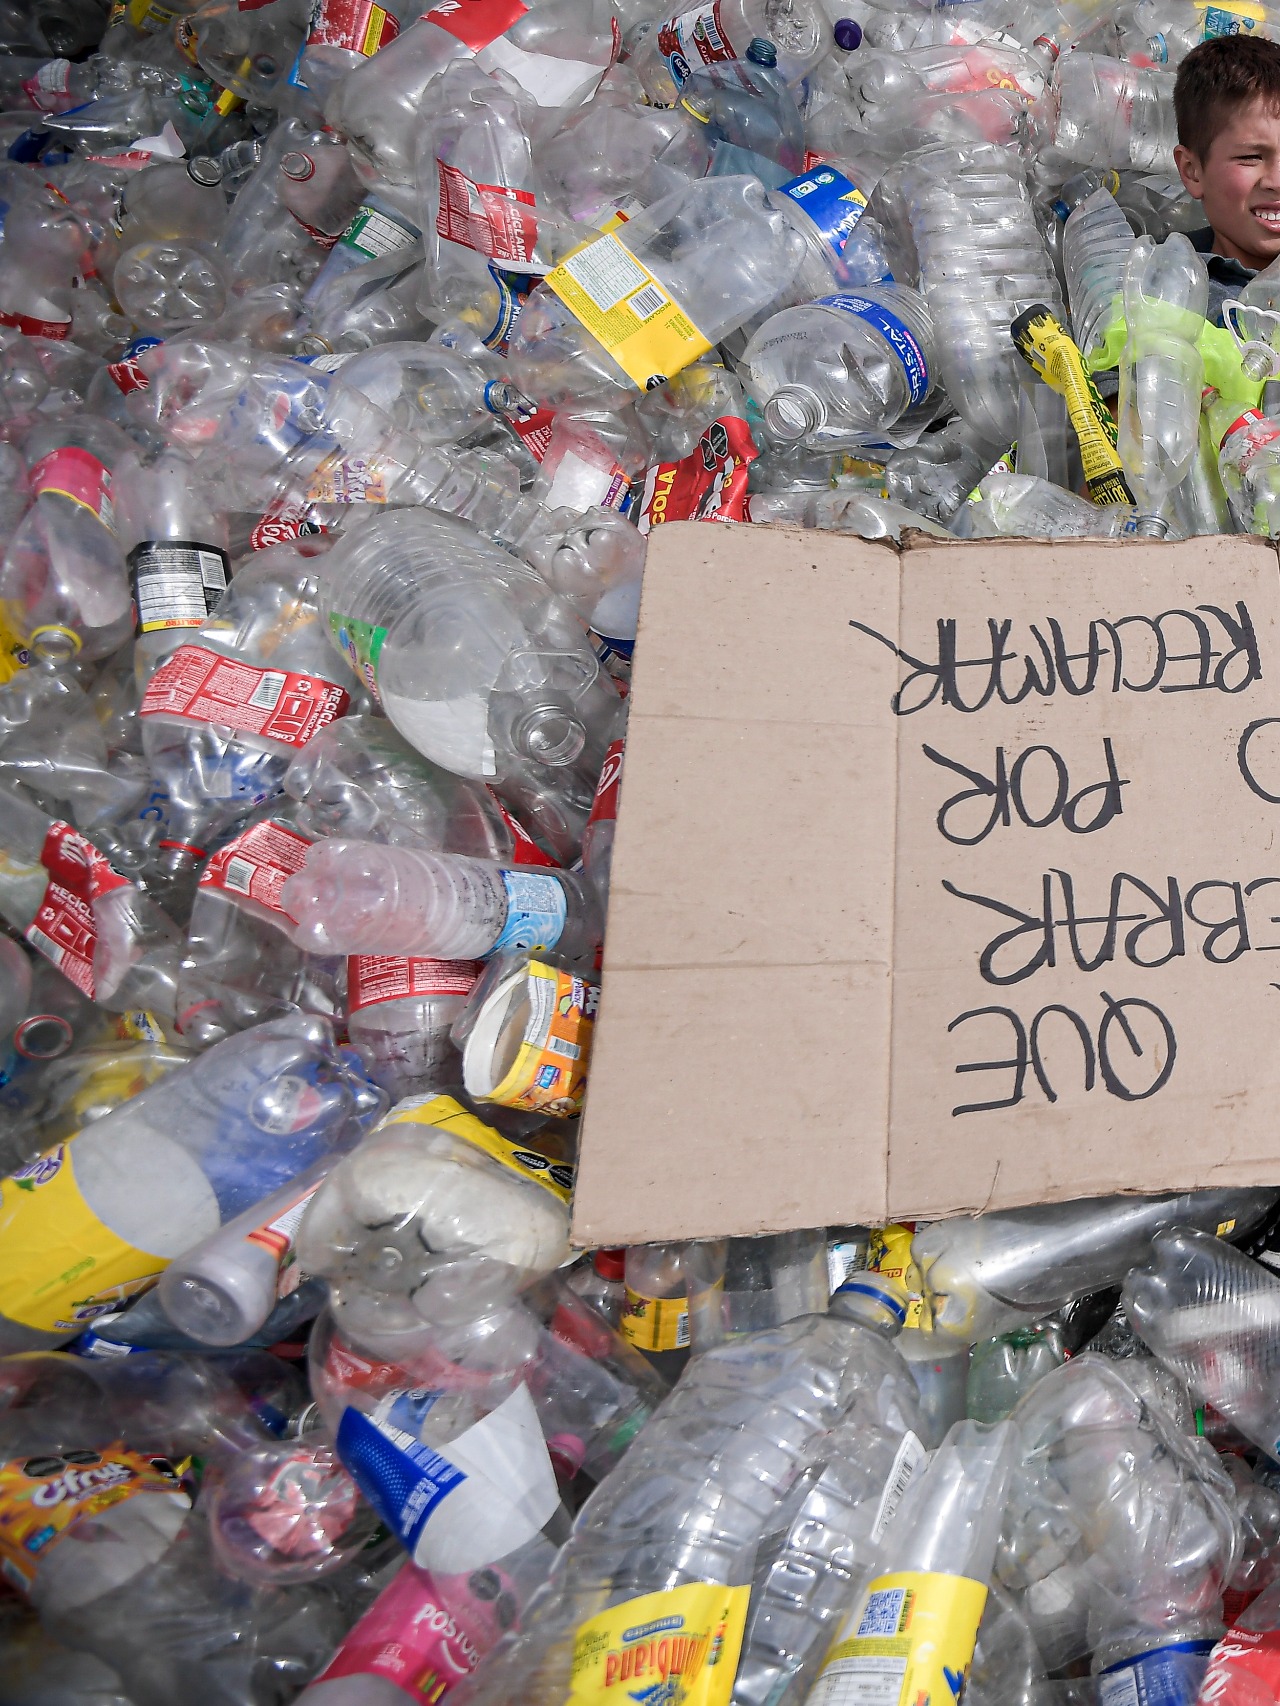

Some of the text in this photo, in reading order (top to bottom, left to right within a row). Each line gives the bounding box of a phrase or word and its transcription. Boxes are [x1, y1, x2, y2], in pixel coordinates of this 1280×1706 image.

[878, 316, 922, 404] CRISTAL
[848, 600, 1264, 717] RECLAMAR
[921, 737, 1131, 847] POR
[947, 992, 1178, 1118] QUE
